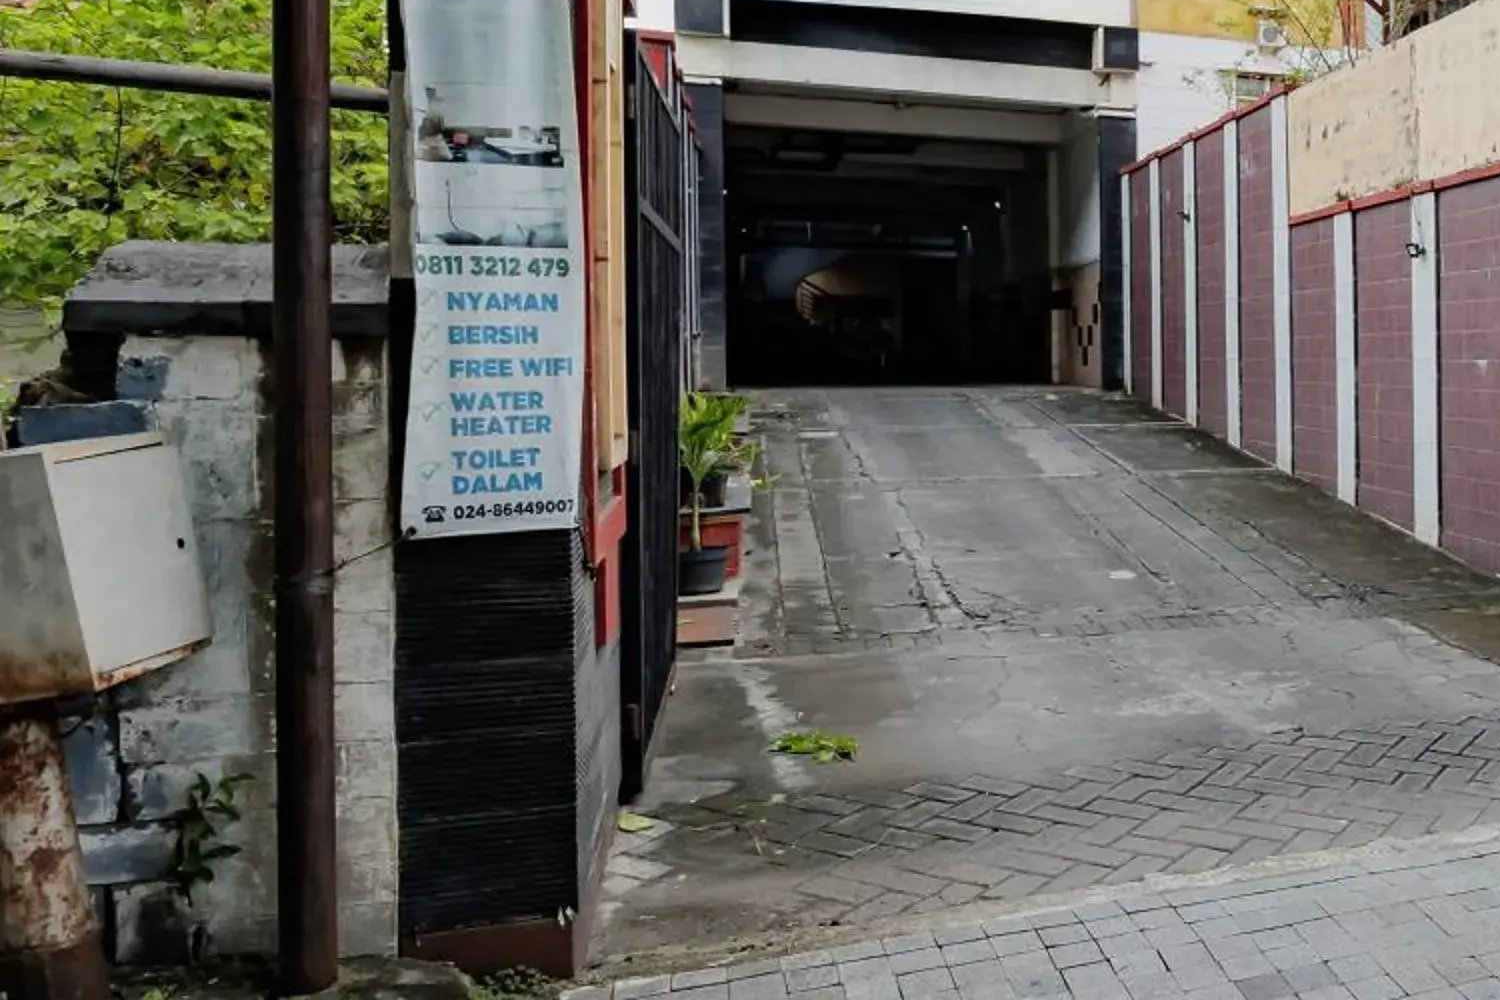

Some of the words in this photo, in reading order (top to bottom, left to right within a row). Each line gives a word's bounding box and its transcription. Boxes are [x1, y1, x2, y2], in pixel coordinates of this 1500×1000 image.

[415, 253, 463, 275] 0811
[470, 255, 521, 277] 3212
[527, 257, 570, 278] 479
[447, 291, 559, 313] NYAMAN
[447, 325, 539, 346] BERSIH
[449, 359, 513, 379] FREE
[520, 357, 573, 377] WIFI
[450, 391, 544, 412] WATER
[450, 415, 552, 437] HEATER
[452, 448, 541, 470] TOILET
[452, 472, 543, 495] DALAM
